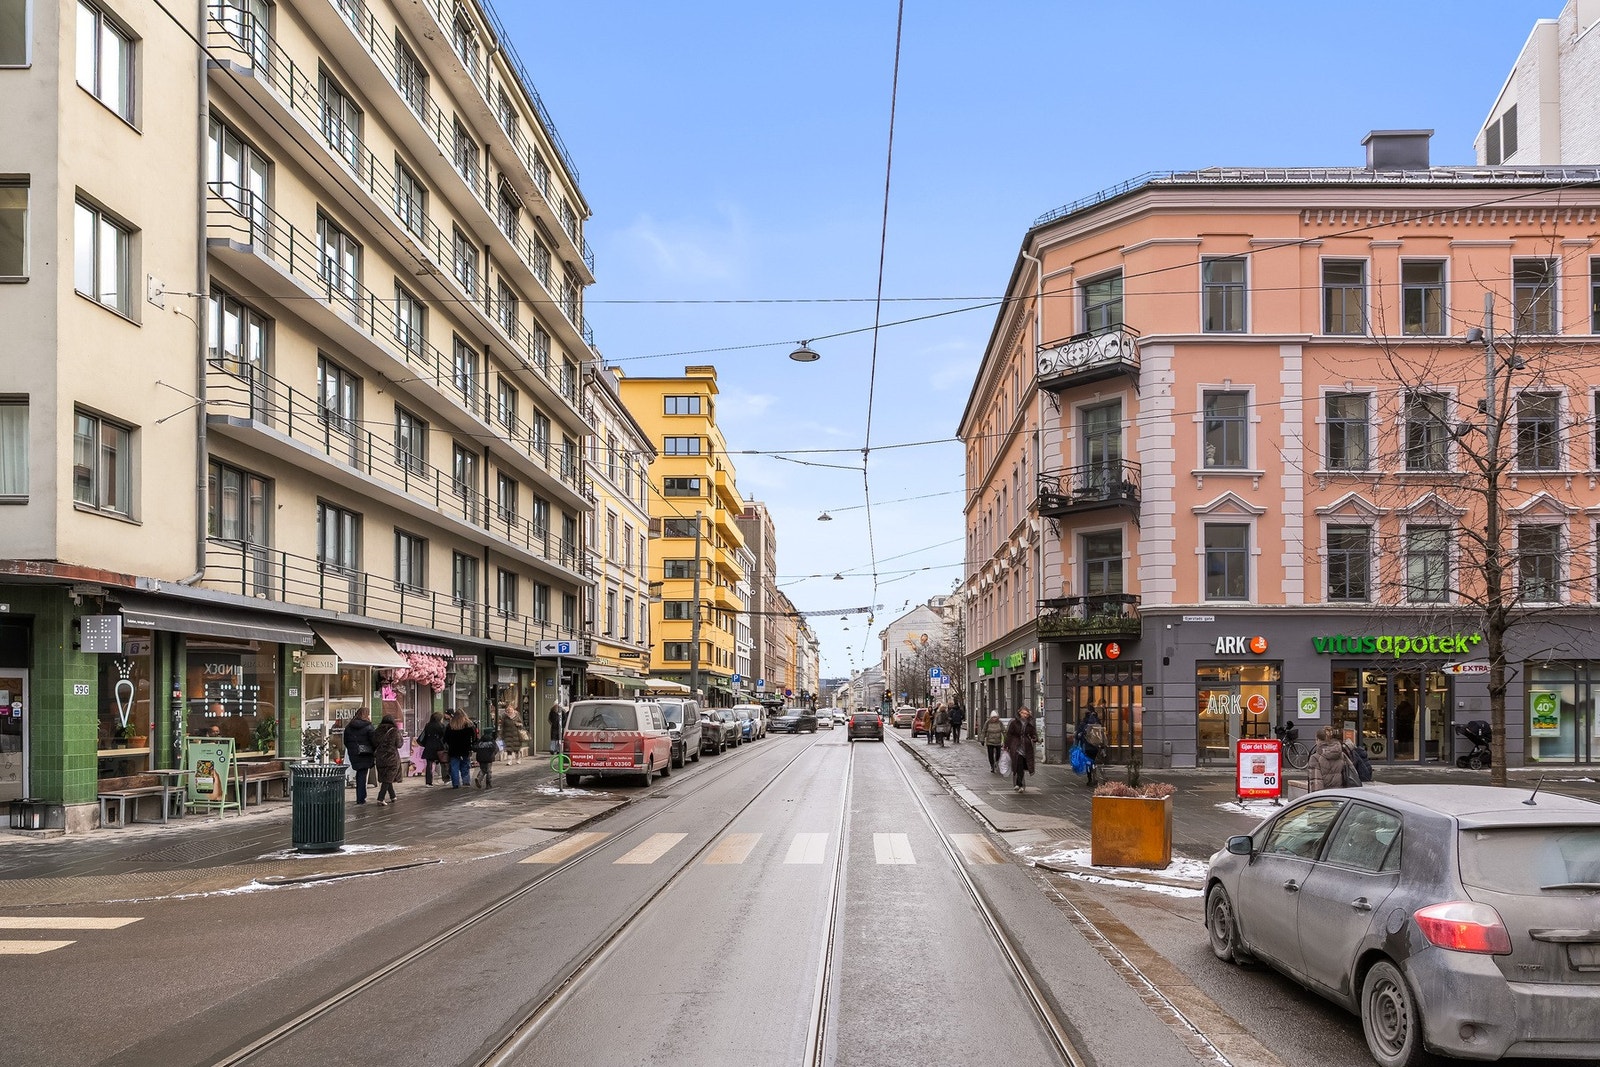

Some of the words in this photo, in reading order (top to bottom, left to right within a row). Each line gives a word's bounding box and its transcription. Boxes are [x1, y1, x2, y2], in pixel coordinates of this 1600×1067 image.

[1078, 643, 1103, 660] ARK
[1215, 636, 1247, 654] ARK
[75, 685, 89, 694] 39G
[1207, 694, 1242, 714] ARK
[1264, 776, 1276, 785] 60
